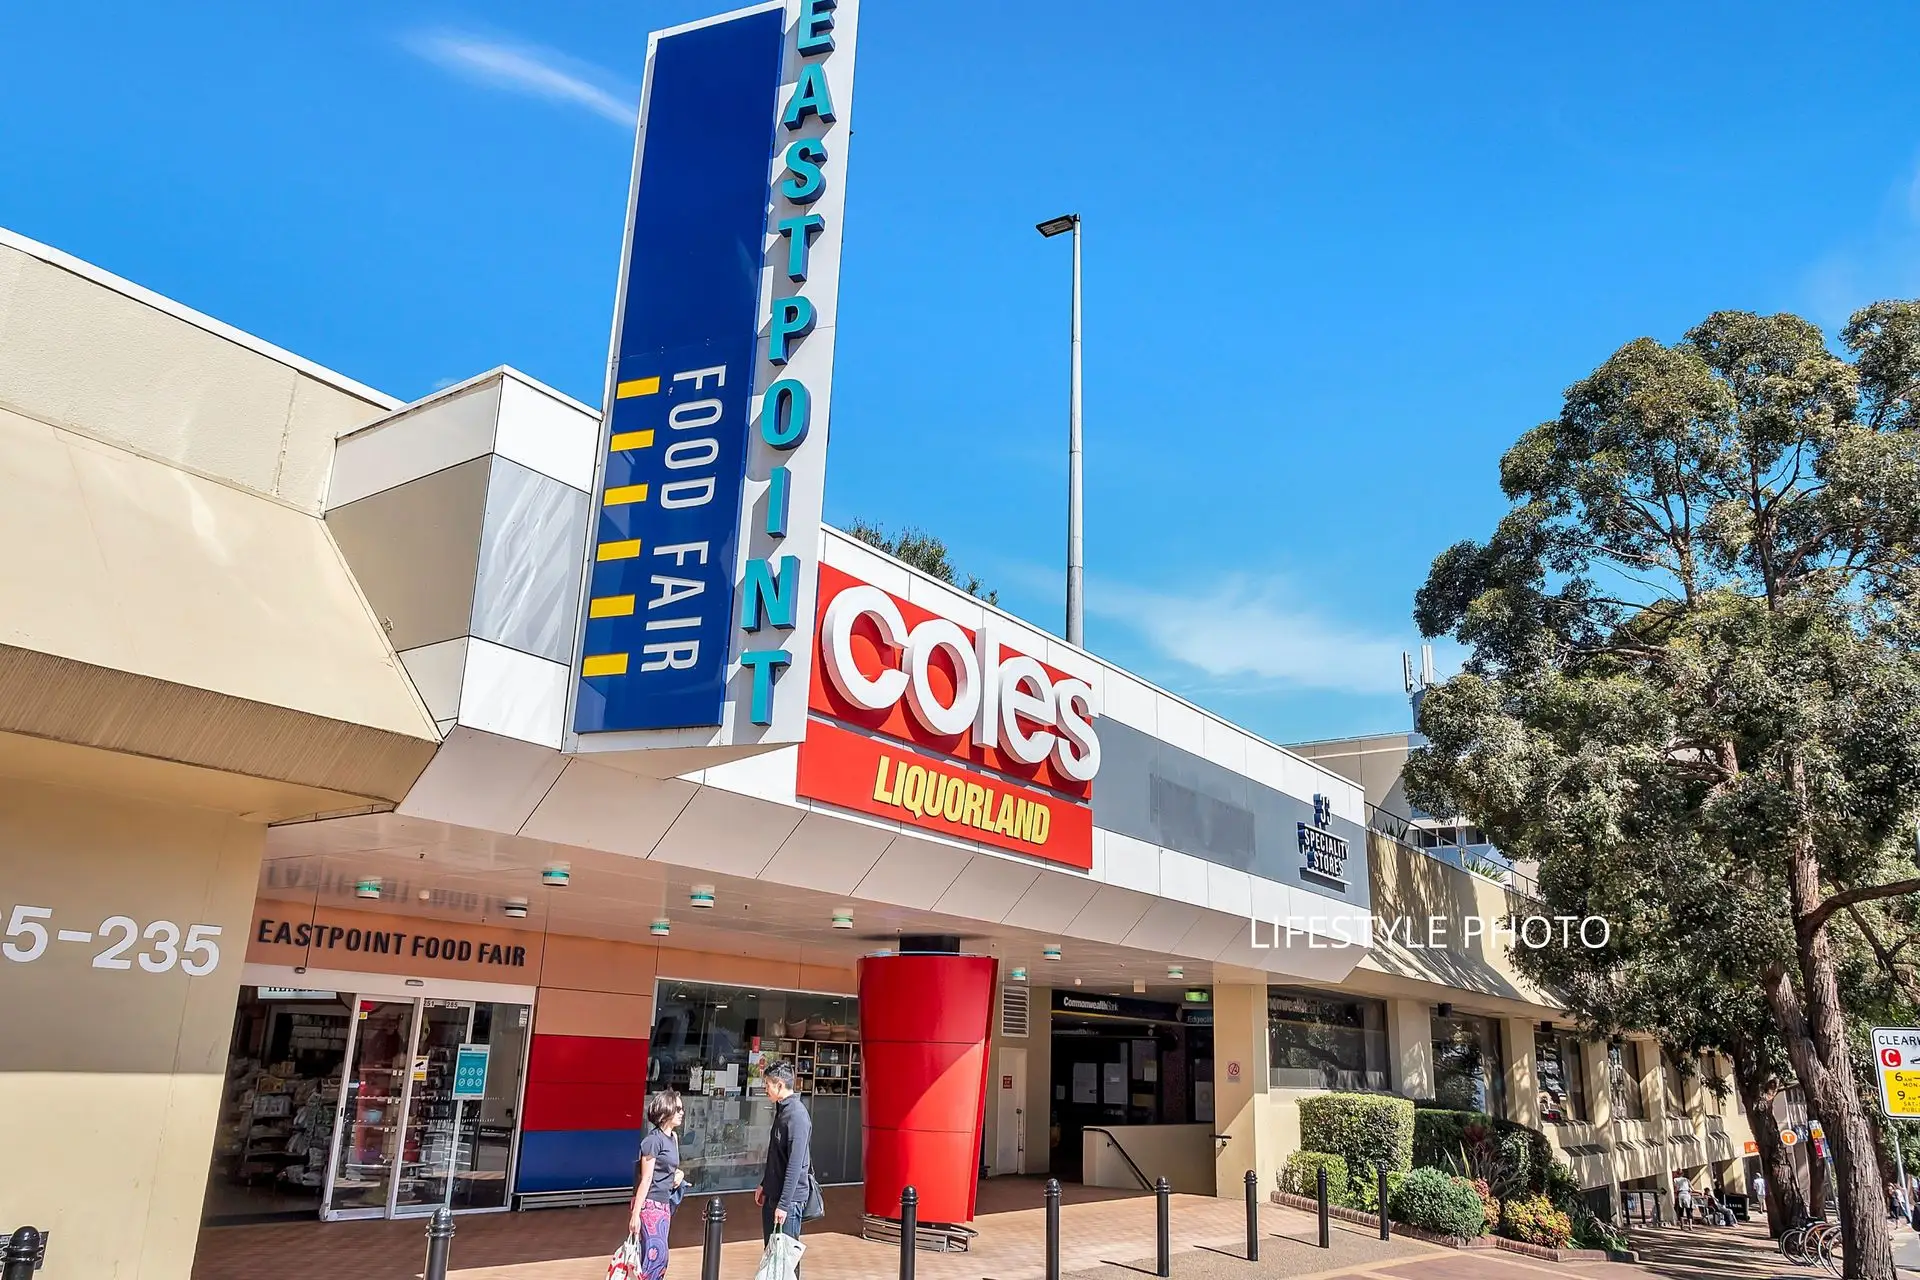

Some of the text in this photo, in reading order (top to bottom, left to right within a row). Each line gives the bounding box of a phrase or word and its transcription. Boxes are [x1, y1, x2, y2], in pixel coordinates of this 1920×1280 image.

[741, 0, 838, 726] EASTPOINT
[640, 364, 727, 673] FOOD FAIR
[822, 585, 1101, 782] coles
[873, 756, 1051, 845] LIQUORLAND
[1304, 828, 1350, 860] SPECIALITY
[1313, 850, 1344, 877] STORES
[0, 904, 223, 976] 5-235
[257, 919, 527, 967] EASTPOINT FOOD FAIR
[1885, 1050, 1897, 1066] C
[1895, 1072, 1903, 1082] 6
[1897, 1090, 1906, 1100] 9
